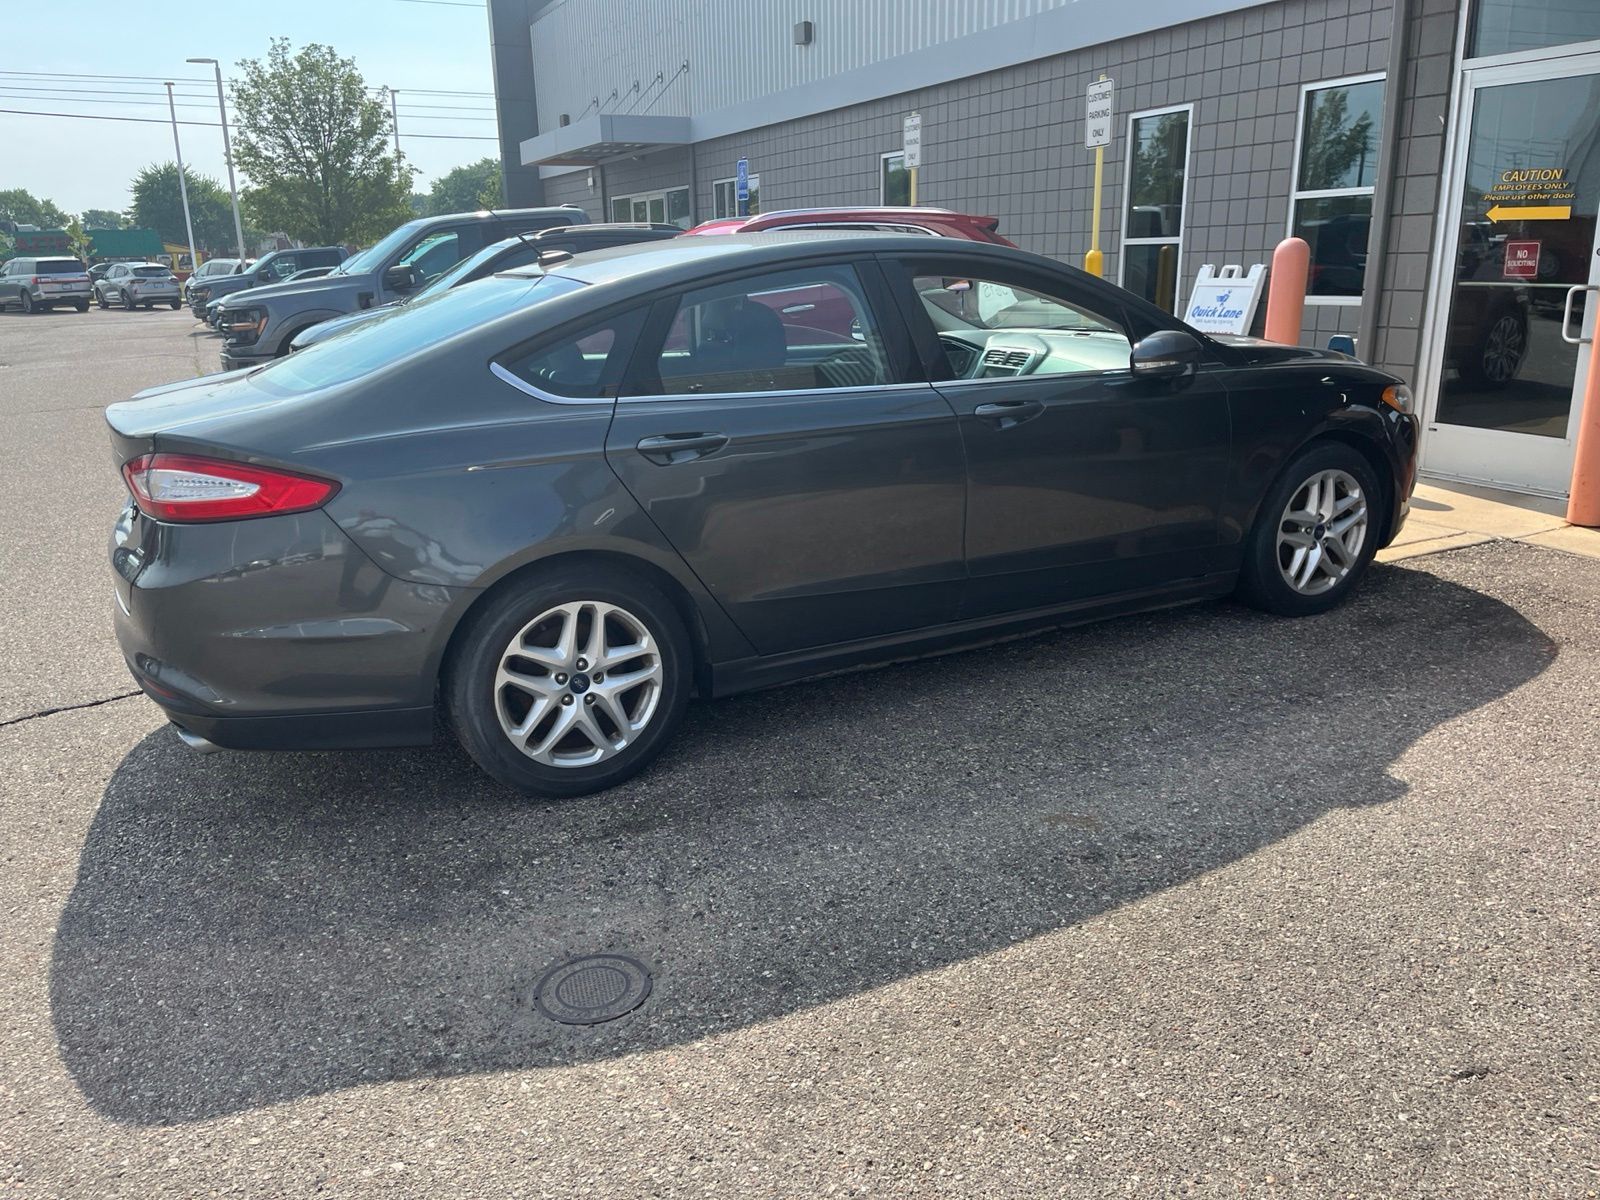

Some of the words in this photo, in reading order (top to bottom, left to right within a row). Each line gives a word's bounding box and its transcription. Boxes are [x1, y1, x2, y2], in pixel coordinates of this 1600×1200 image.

[1088, 90, 1111, 103] CUSTOMER
[1088, 108, 1110, 120] PARKING
[1092, 128, 1105, 138] ONLY
[1502, 168, 1563, 182] CAUTION
[1493, 183, 1543, 192] EMPLOYEES
[1543, 182, 1569, 190] ONLY
[1516, 249, 1529, 259] NO
[1191, 305, 1218, 318] Quick
[1217, 306, 1243, 319] Lane
